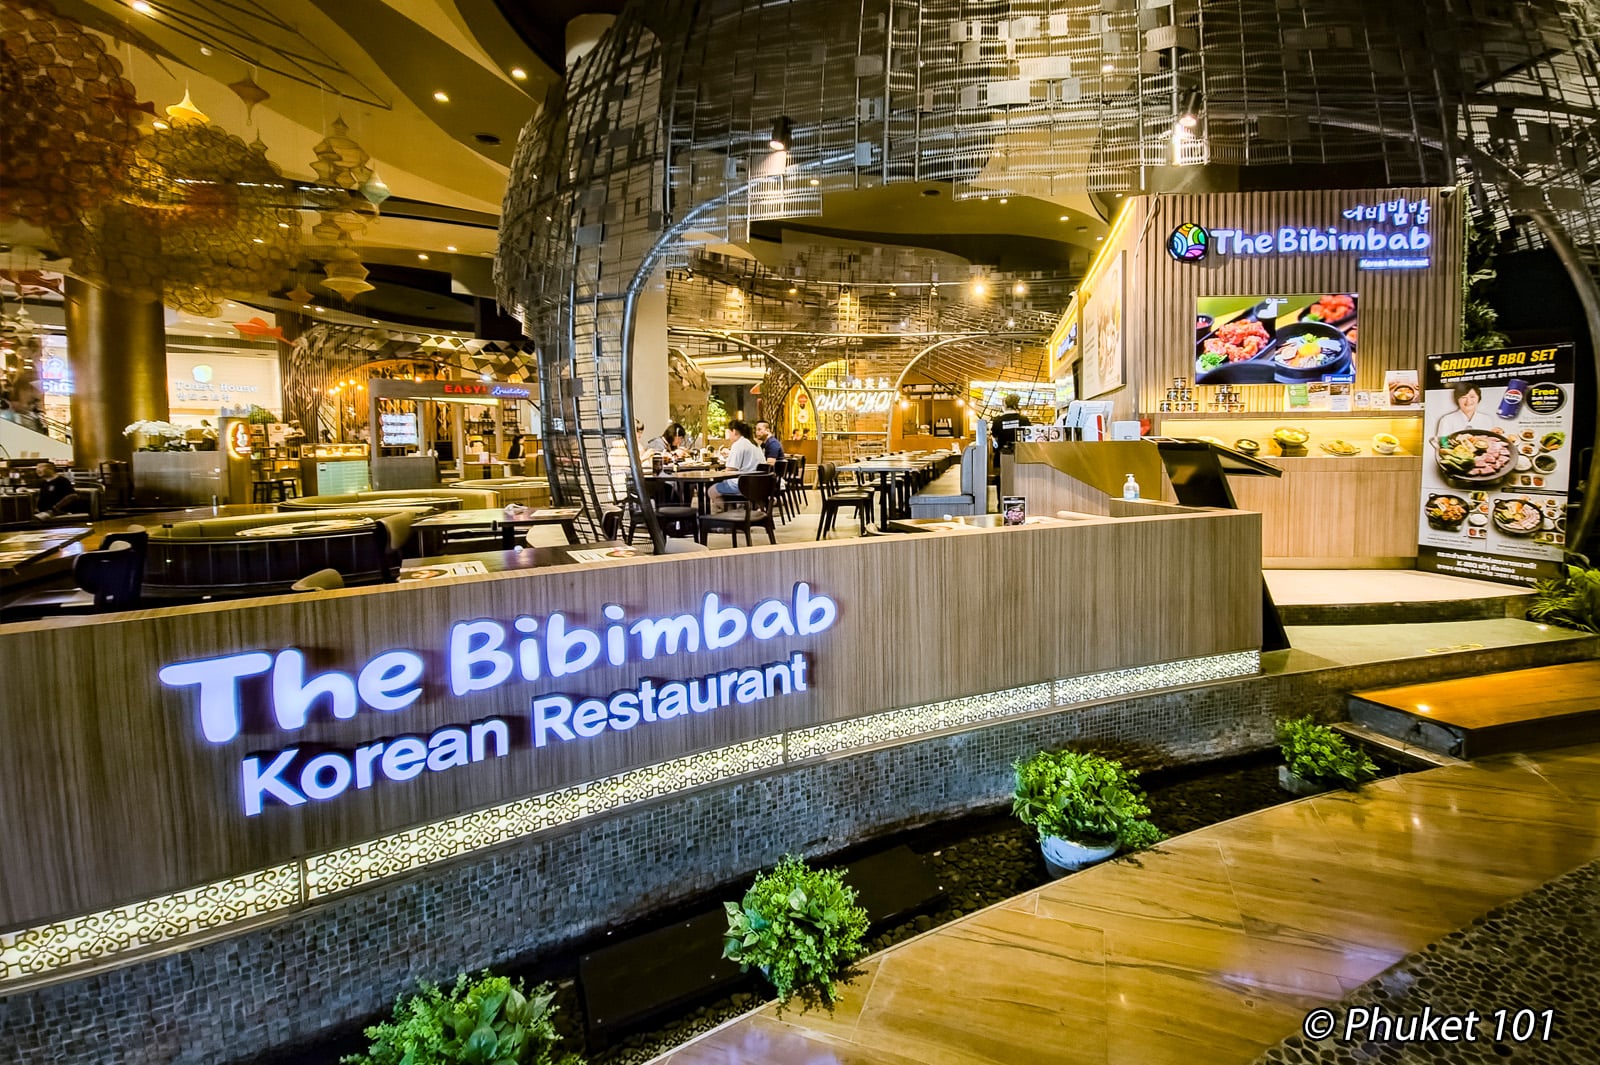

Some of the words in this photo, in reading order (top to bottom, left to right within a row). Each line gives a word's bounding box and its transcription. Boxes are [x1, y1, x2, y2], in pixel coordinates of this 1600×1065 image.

[1210, 228, 1273, 255] The
[1278, 225, 1431, 253] Bibimbab
[1360, 259, 1387, 268] Korean
[1388, 258, 1429, 268] Restaurant
[1440, 355, 1494, 370] GRIDDLE
[1498, 352, 1526, 365] BBQ
[1530, 348, 1558, 362] SET
[1531, 388, 1559, 396] Free!
[158, 649, 425, 743] The
[449, 581, 837, 696] Bibimbab
[242, 718, 508, 817] Korean
[532, 651, 807, 748] Restaurant
